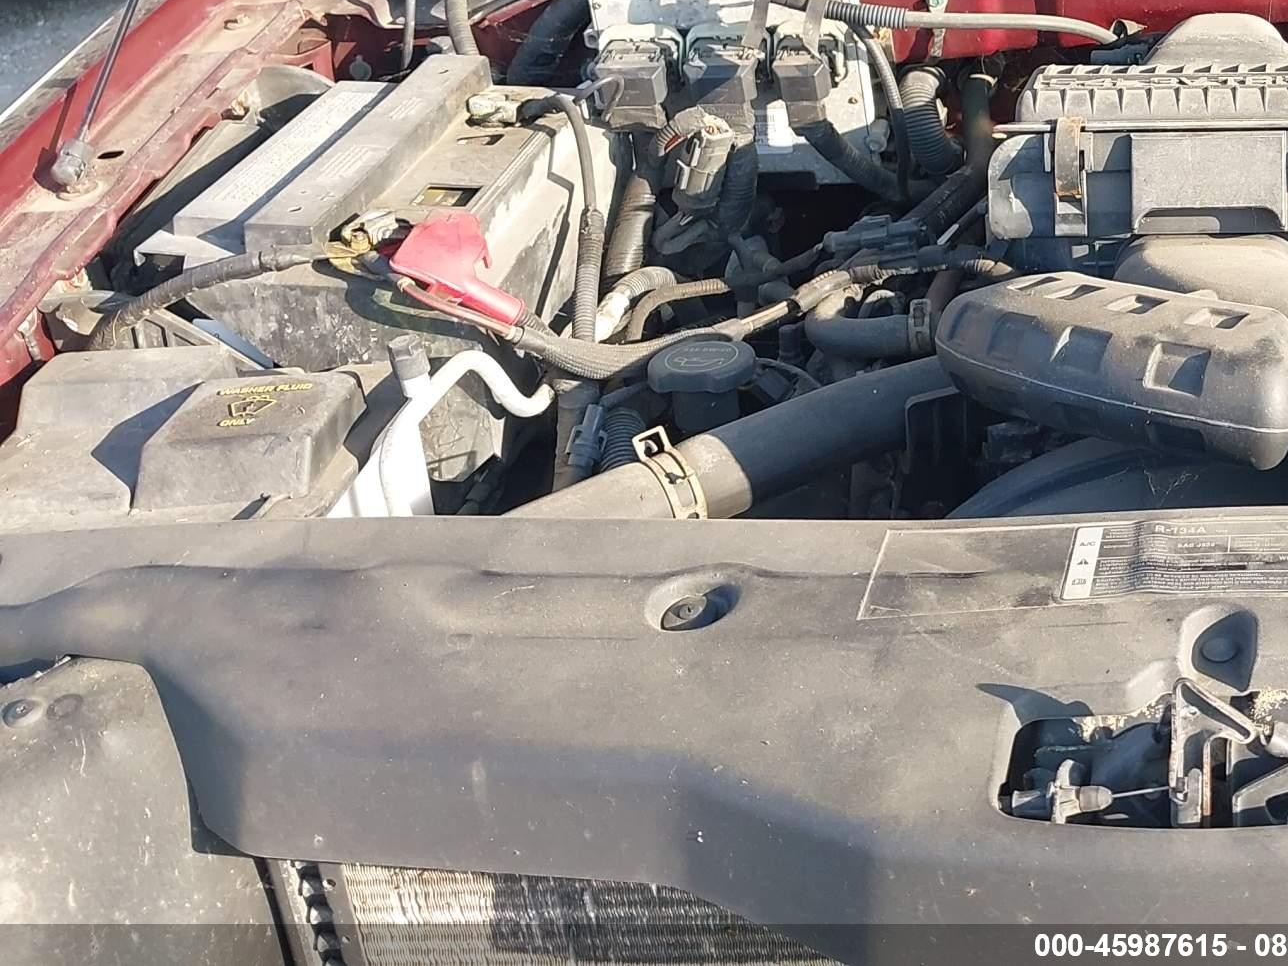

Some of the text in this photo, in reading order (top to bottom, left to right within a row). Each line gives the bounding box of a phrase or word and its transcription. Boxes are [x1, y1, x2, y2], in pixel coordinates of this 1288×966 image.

[217, 382, 314, 395] WASHER FLUID
[217, 417, 257, 427] ONLY
[1154, 524, 1207, 535] R-134A
